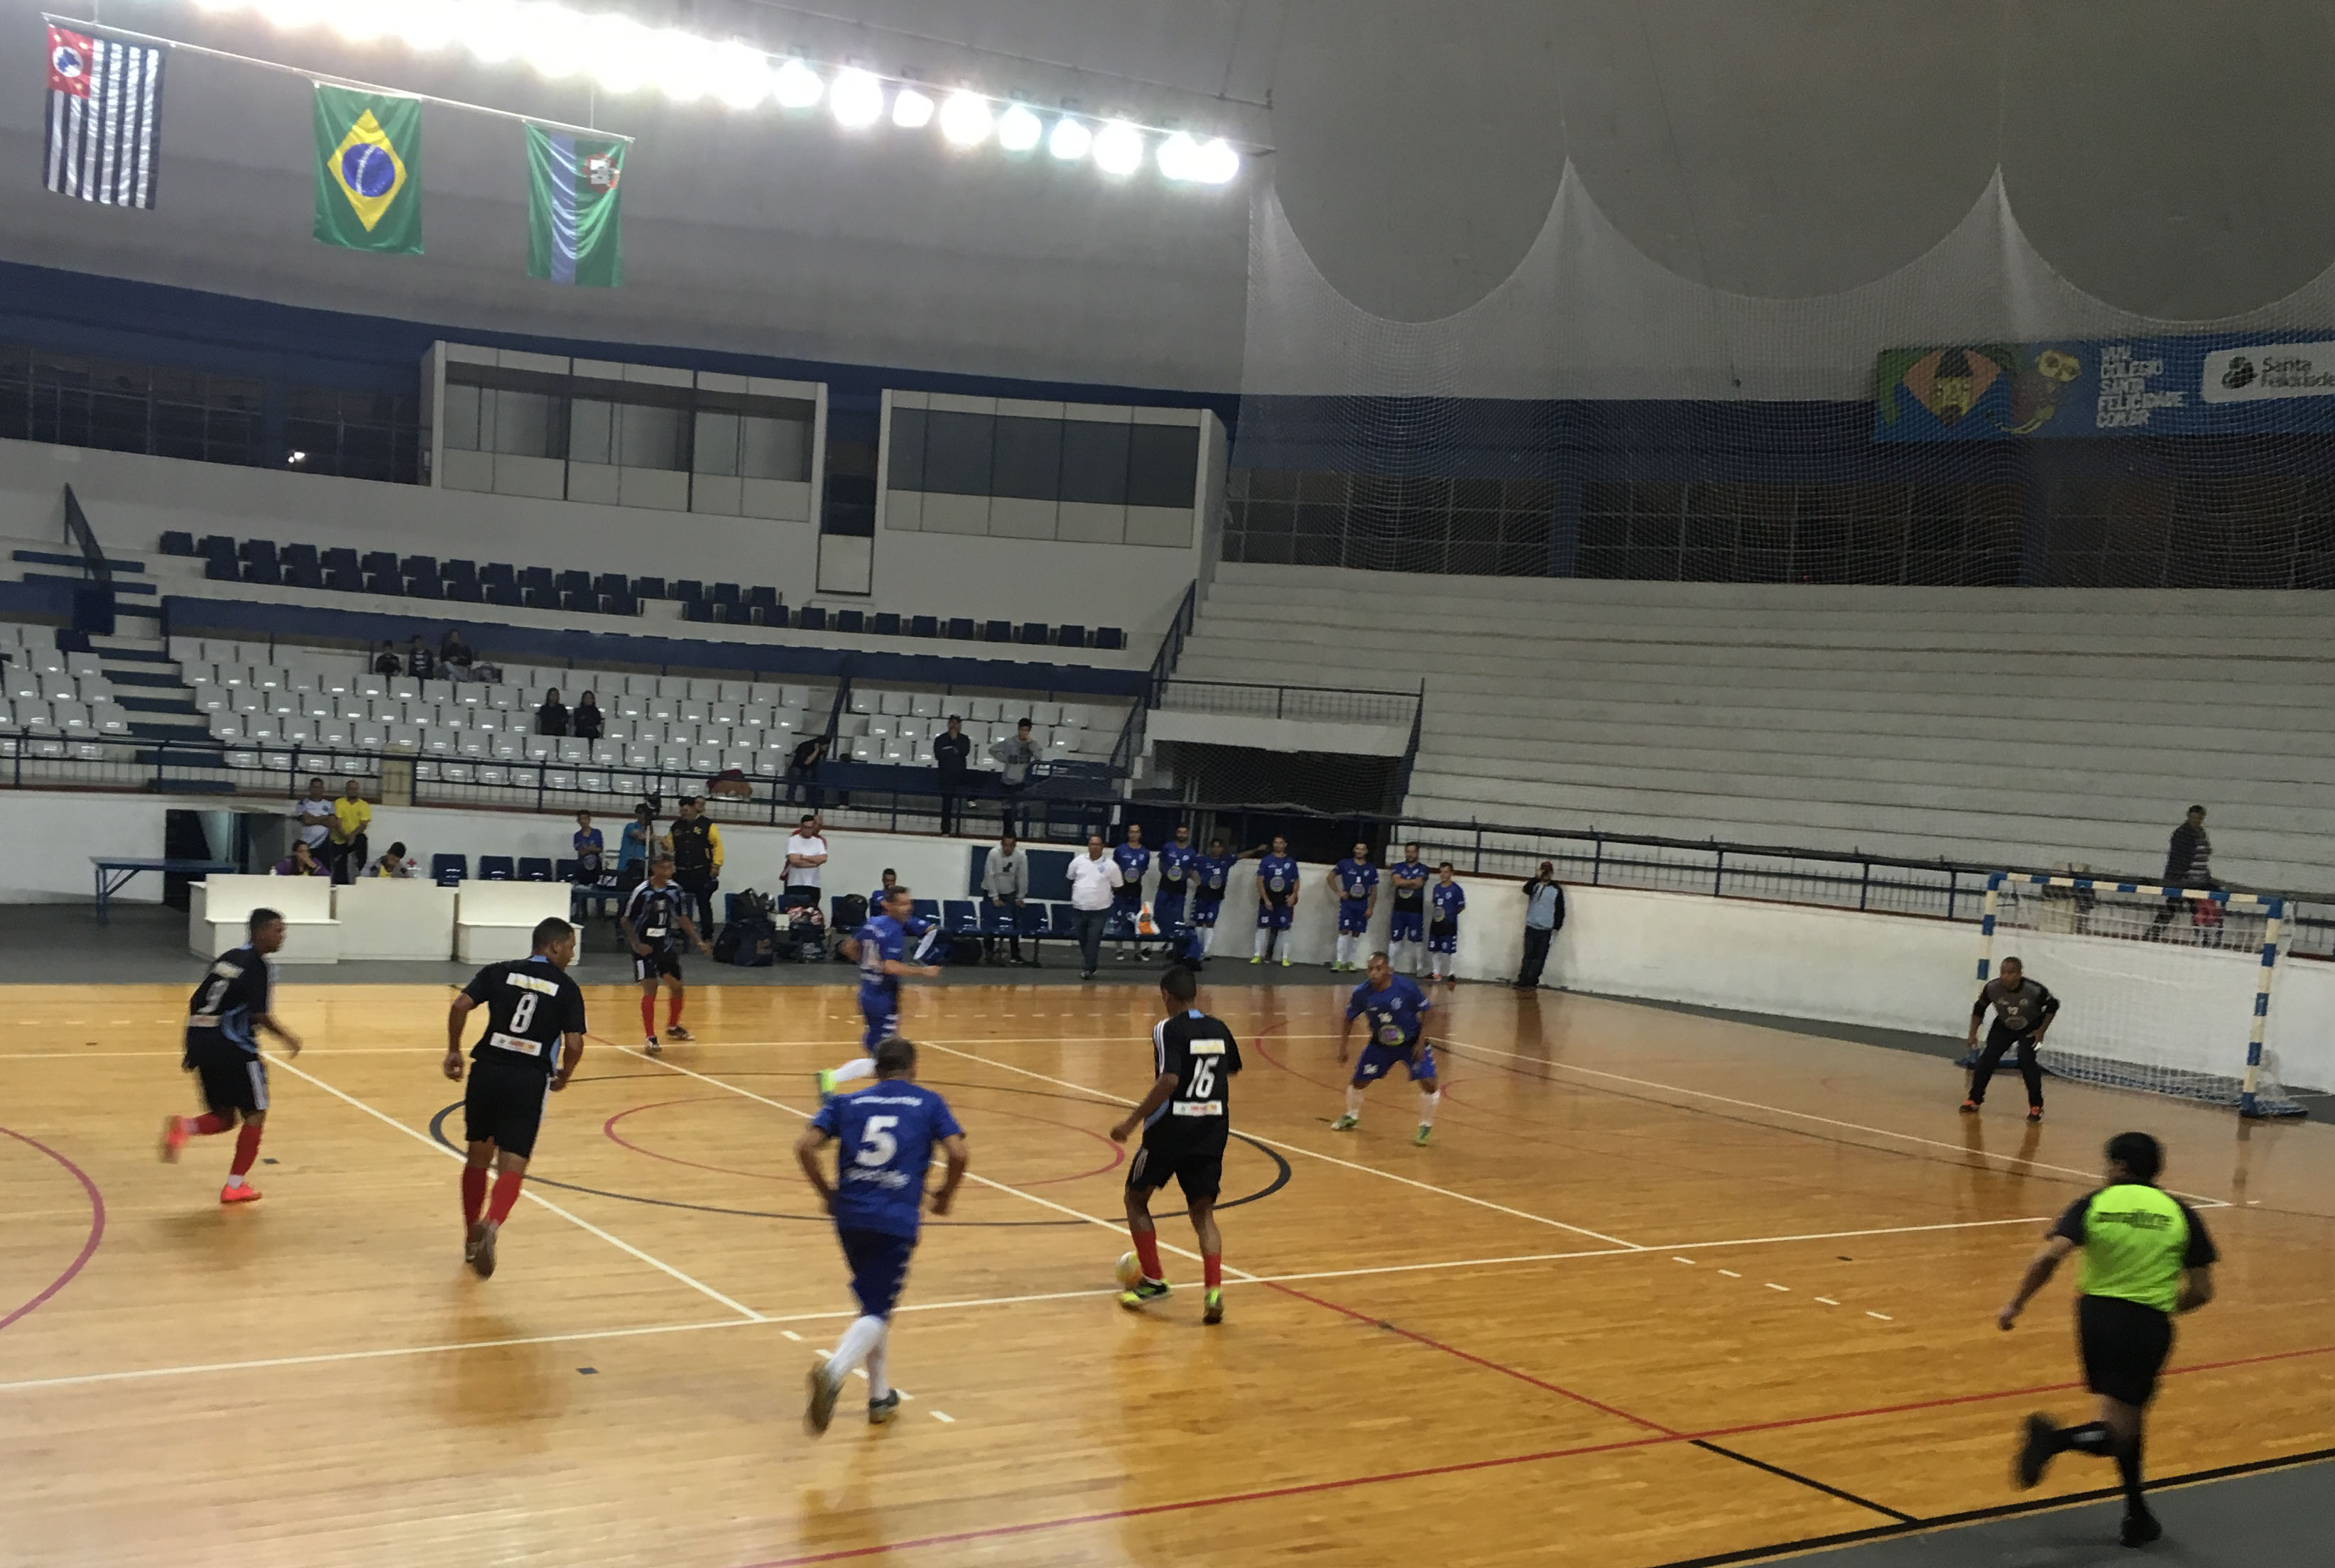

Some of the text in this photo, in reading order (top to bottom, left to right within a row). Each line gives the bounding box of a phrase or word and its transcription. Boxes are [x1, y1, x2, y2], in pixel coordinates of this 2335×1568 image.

[2262, 356, 2312, 373] Santa
[509, 992, 538, 1033] 8
[1185, 1055, 1219, 1099] 16
[854, 1115, 899, 1167] 5
